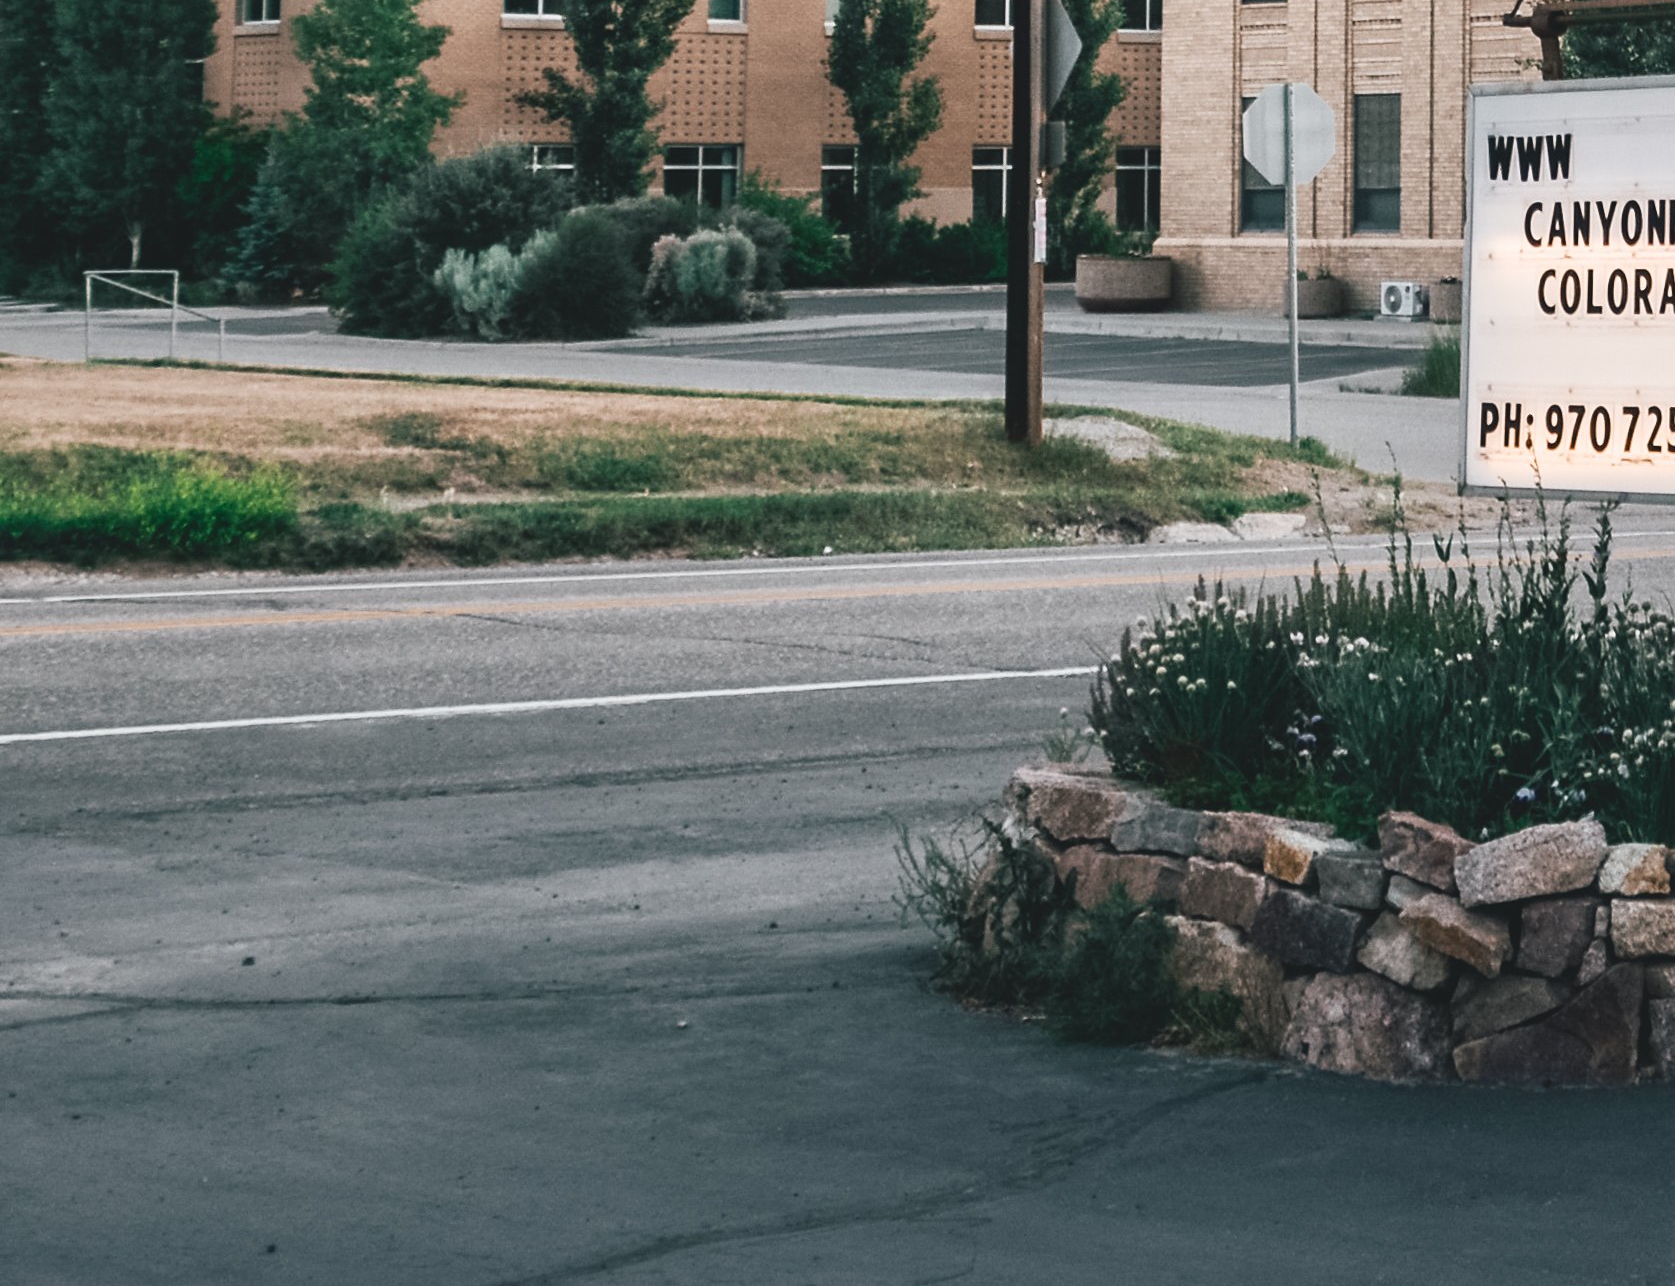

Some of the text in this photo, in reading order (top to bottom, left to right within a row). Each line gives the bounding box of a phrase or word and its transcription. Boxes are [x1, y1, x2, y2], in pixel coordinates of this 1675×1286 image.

[1487, 133, 1573, 182] WWW
[1480, 402, 1535, 449] PH:
[1545, 404, 1612, 454] 970
